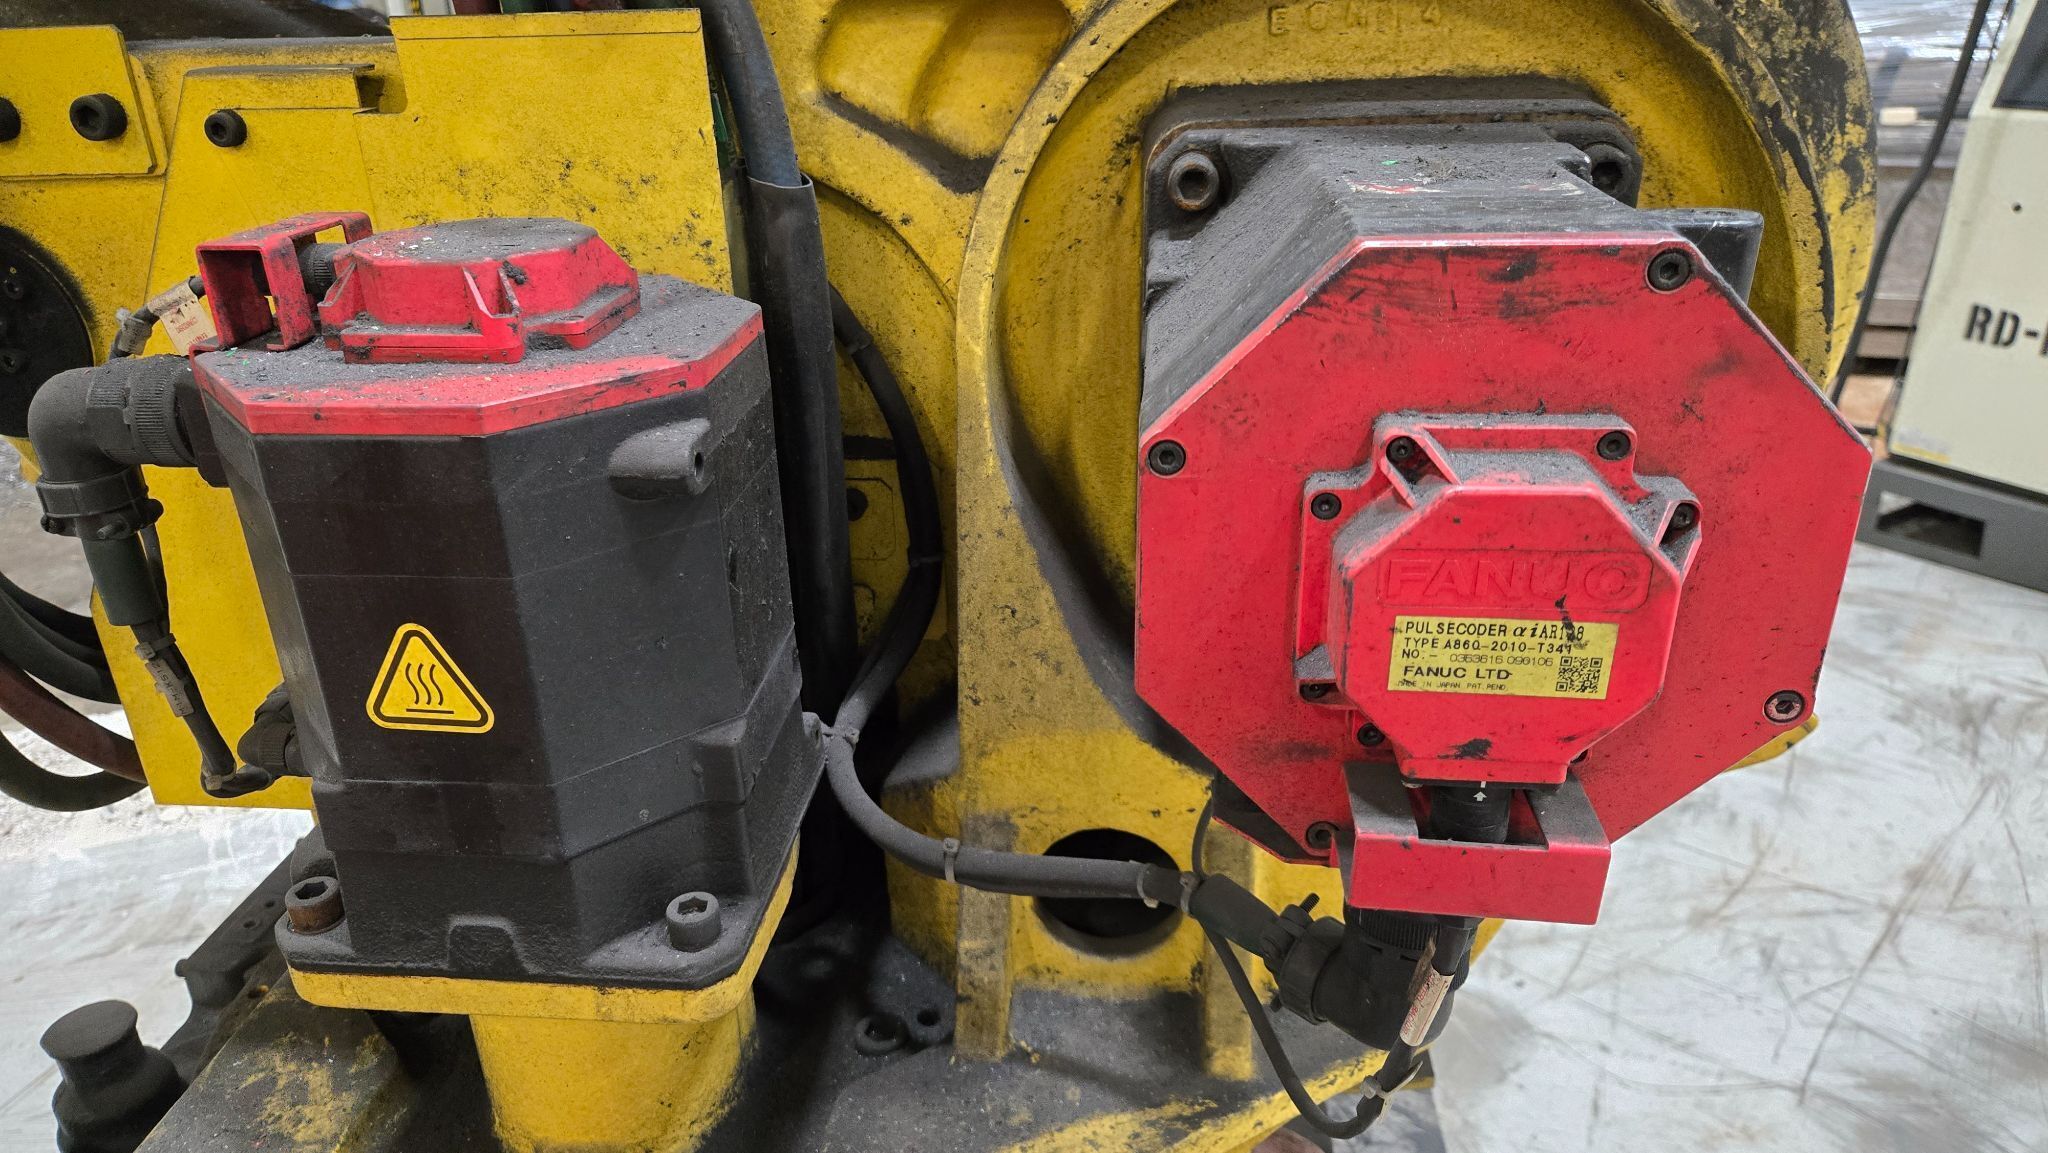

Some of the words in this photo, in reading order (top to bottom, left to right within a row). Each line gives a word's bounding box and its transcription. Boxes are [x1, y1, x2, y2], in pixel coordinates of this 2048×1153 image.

[1385, 558, 1641, 602] FANUC
[1405, 621, 1507, 637] PULSECODER
[1404, 636, 1440, 649] TYPE
[1403, 665, 1467, 679] FANUC
[1475, 668, 1512, 680] LTD
[1436, 681, 1460, 690] JAPAN
